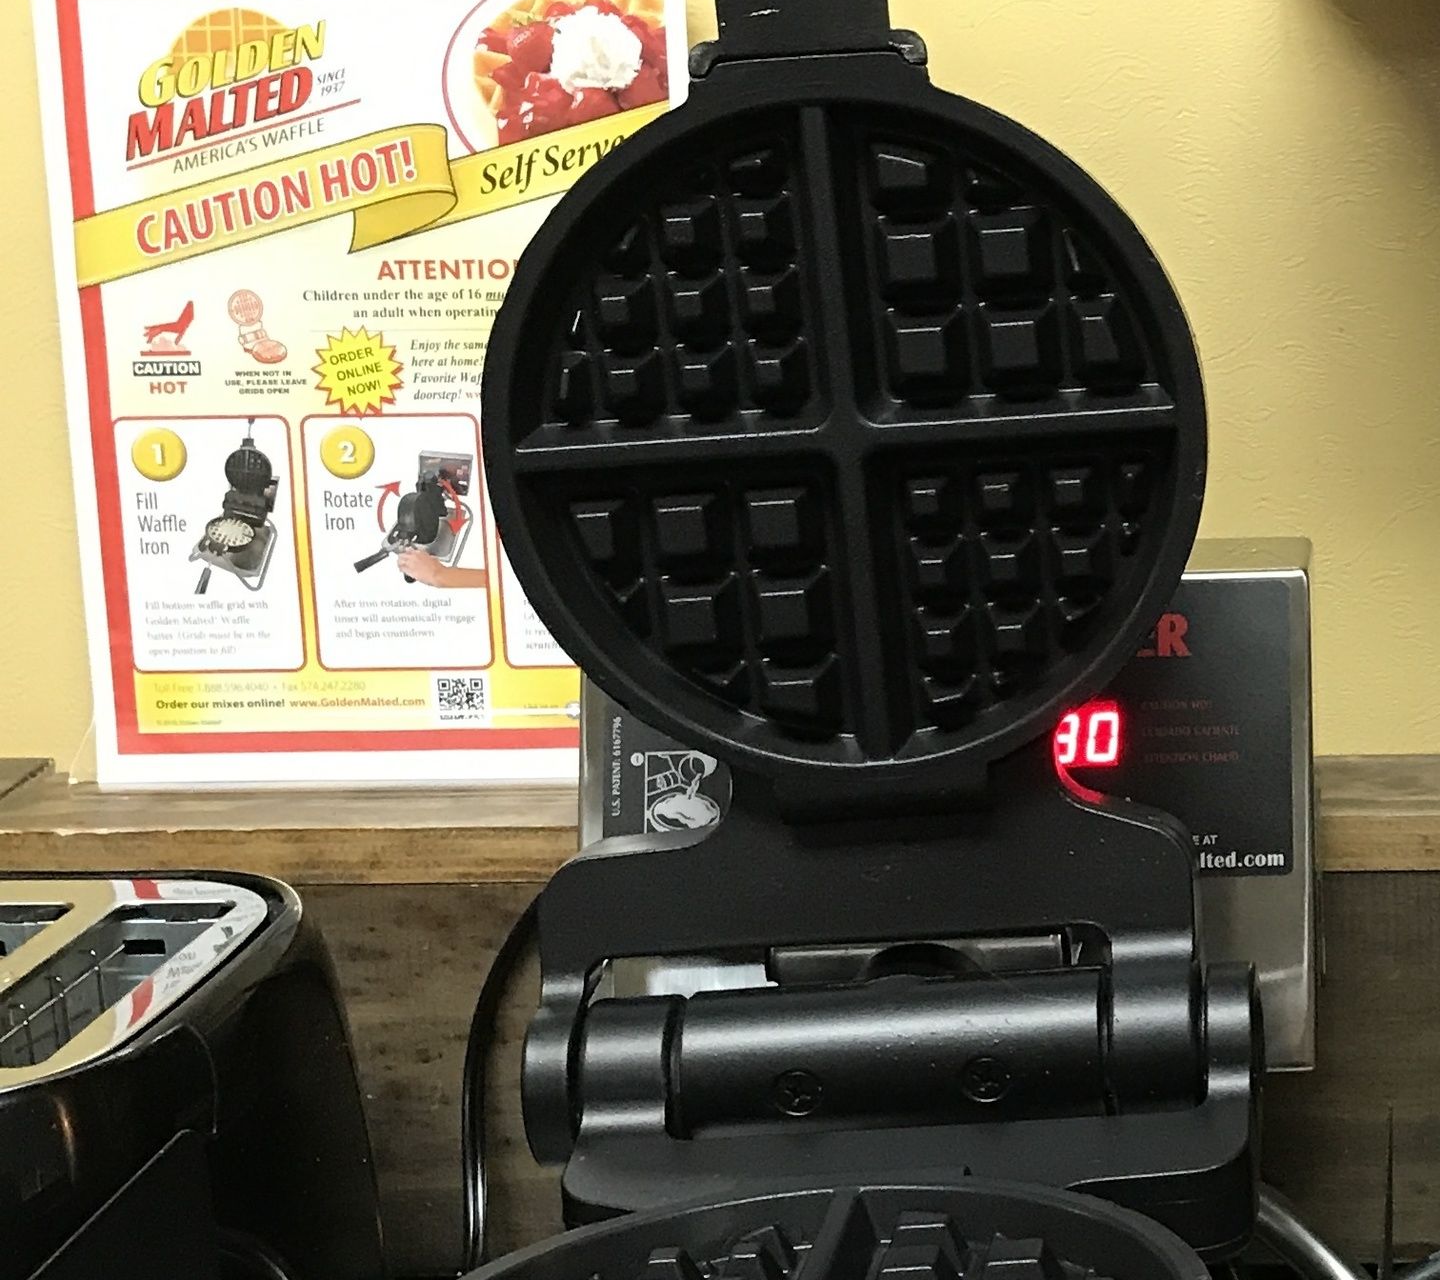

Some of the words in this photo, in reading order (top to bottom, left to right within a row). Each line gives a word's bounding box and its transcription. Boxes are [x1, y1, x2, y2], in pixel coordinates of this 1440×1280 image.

[138, 19, 326, 108] GOLDEN
[320, 80, 346, 97] 1937
[126, 66, 313, 161] MALTED
[317, 68, 346, 84] SINCE
[173, 134, 257, 174] AMERICA'S
[262, 117, 325, 148] WAFFLE
[480, 148, 540, 195] Self
[136, 170, 311, 254] CAUTION
[320, 140, 417, 203] HOT!
[377, 259, 519, 280] ATTENTIO
[302, 289, 359, 301] Children
[363, 289, 400, 300] under
[404, 289, 423, 300] the
[427, 292, 448, 302] age
[451, 288, 465, 300] of
[468, 289, 482, 300] 16
[353, 308, 368, 318] an
[372, 307, 404, 318] adult
[408, 306, 441, 317] when
[410, 339, 441, 352] Enjoy
[444, 338, 460, 350] the
[329, 347, 374, 366] ORDER
[411, 357, 434, 367] here
[437, 357, 447, 367] at
[450, 355, 484, 367] home!
[133, 362, 200, 375] CAUTION
[336, 362, 383, 382] ONLINE
[413, 372, 456, 384] Favorite
[149, 381, 188, 394] HOT
[346, 381, 382, 397] NOW!
[413, 388, 462, 402] doorstep!
[151, 443, 165, 466] 1
[337, 440, 357, 464] 2
[135, 492, 158, 510] Fill
[324, 490, 373, 508] Rotate
[138, 515, 187, 532] Waffle
[325, 513, 355, 530] Iron
[139, 538, 170, 555] Iron
[227, 600, 246, 612] grid
[248, 600, 269, 609] with
[334, 599, 356, 608] After
[423, 598, 452, 609] digital
[362, 614, 378, 624] will
[381, 613, 442, 624] automatically
[445, 614, 476, 625] engage
[336, 628, 353, 638] and
[355, 628, 381, 640] begin
[155, 699, 188, 709] Order
[191, 701, 209, 709] our
[213, 699, 244, 709] mixes
[248, 698, 285, 708] online!
[290, 696, 425, 708] www.GoldenMalted.com
